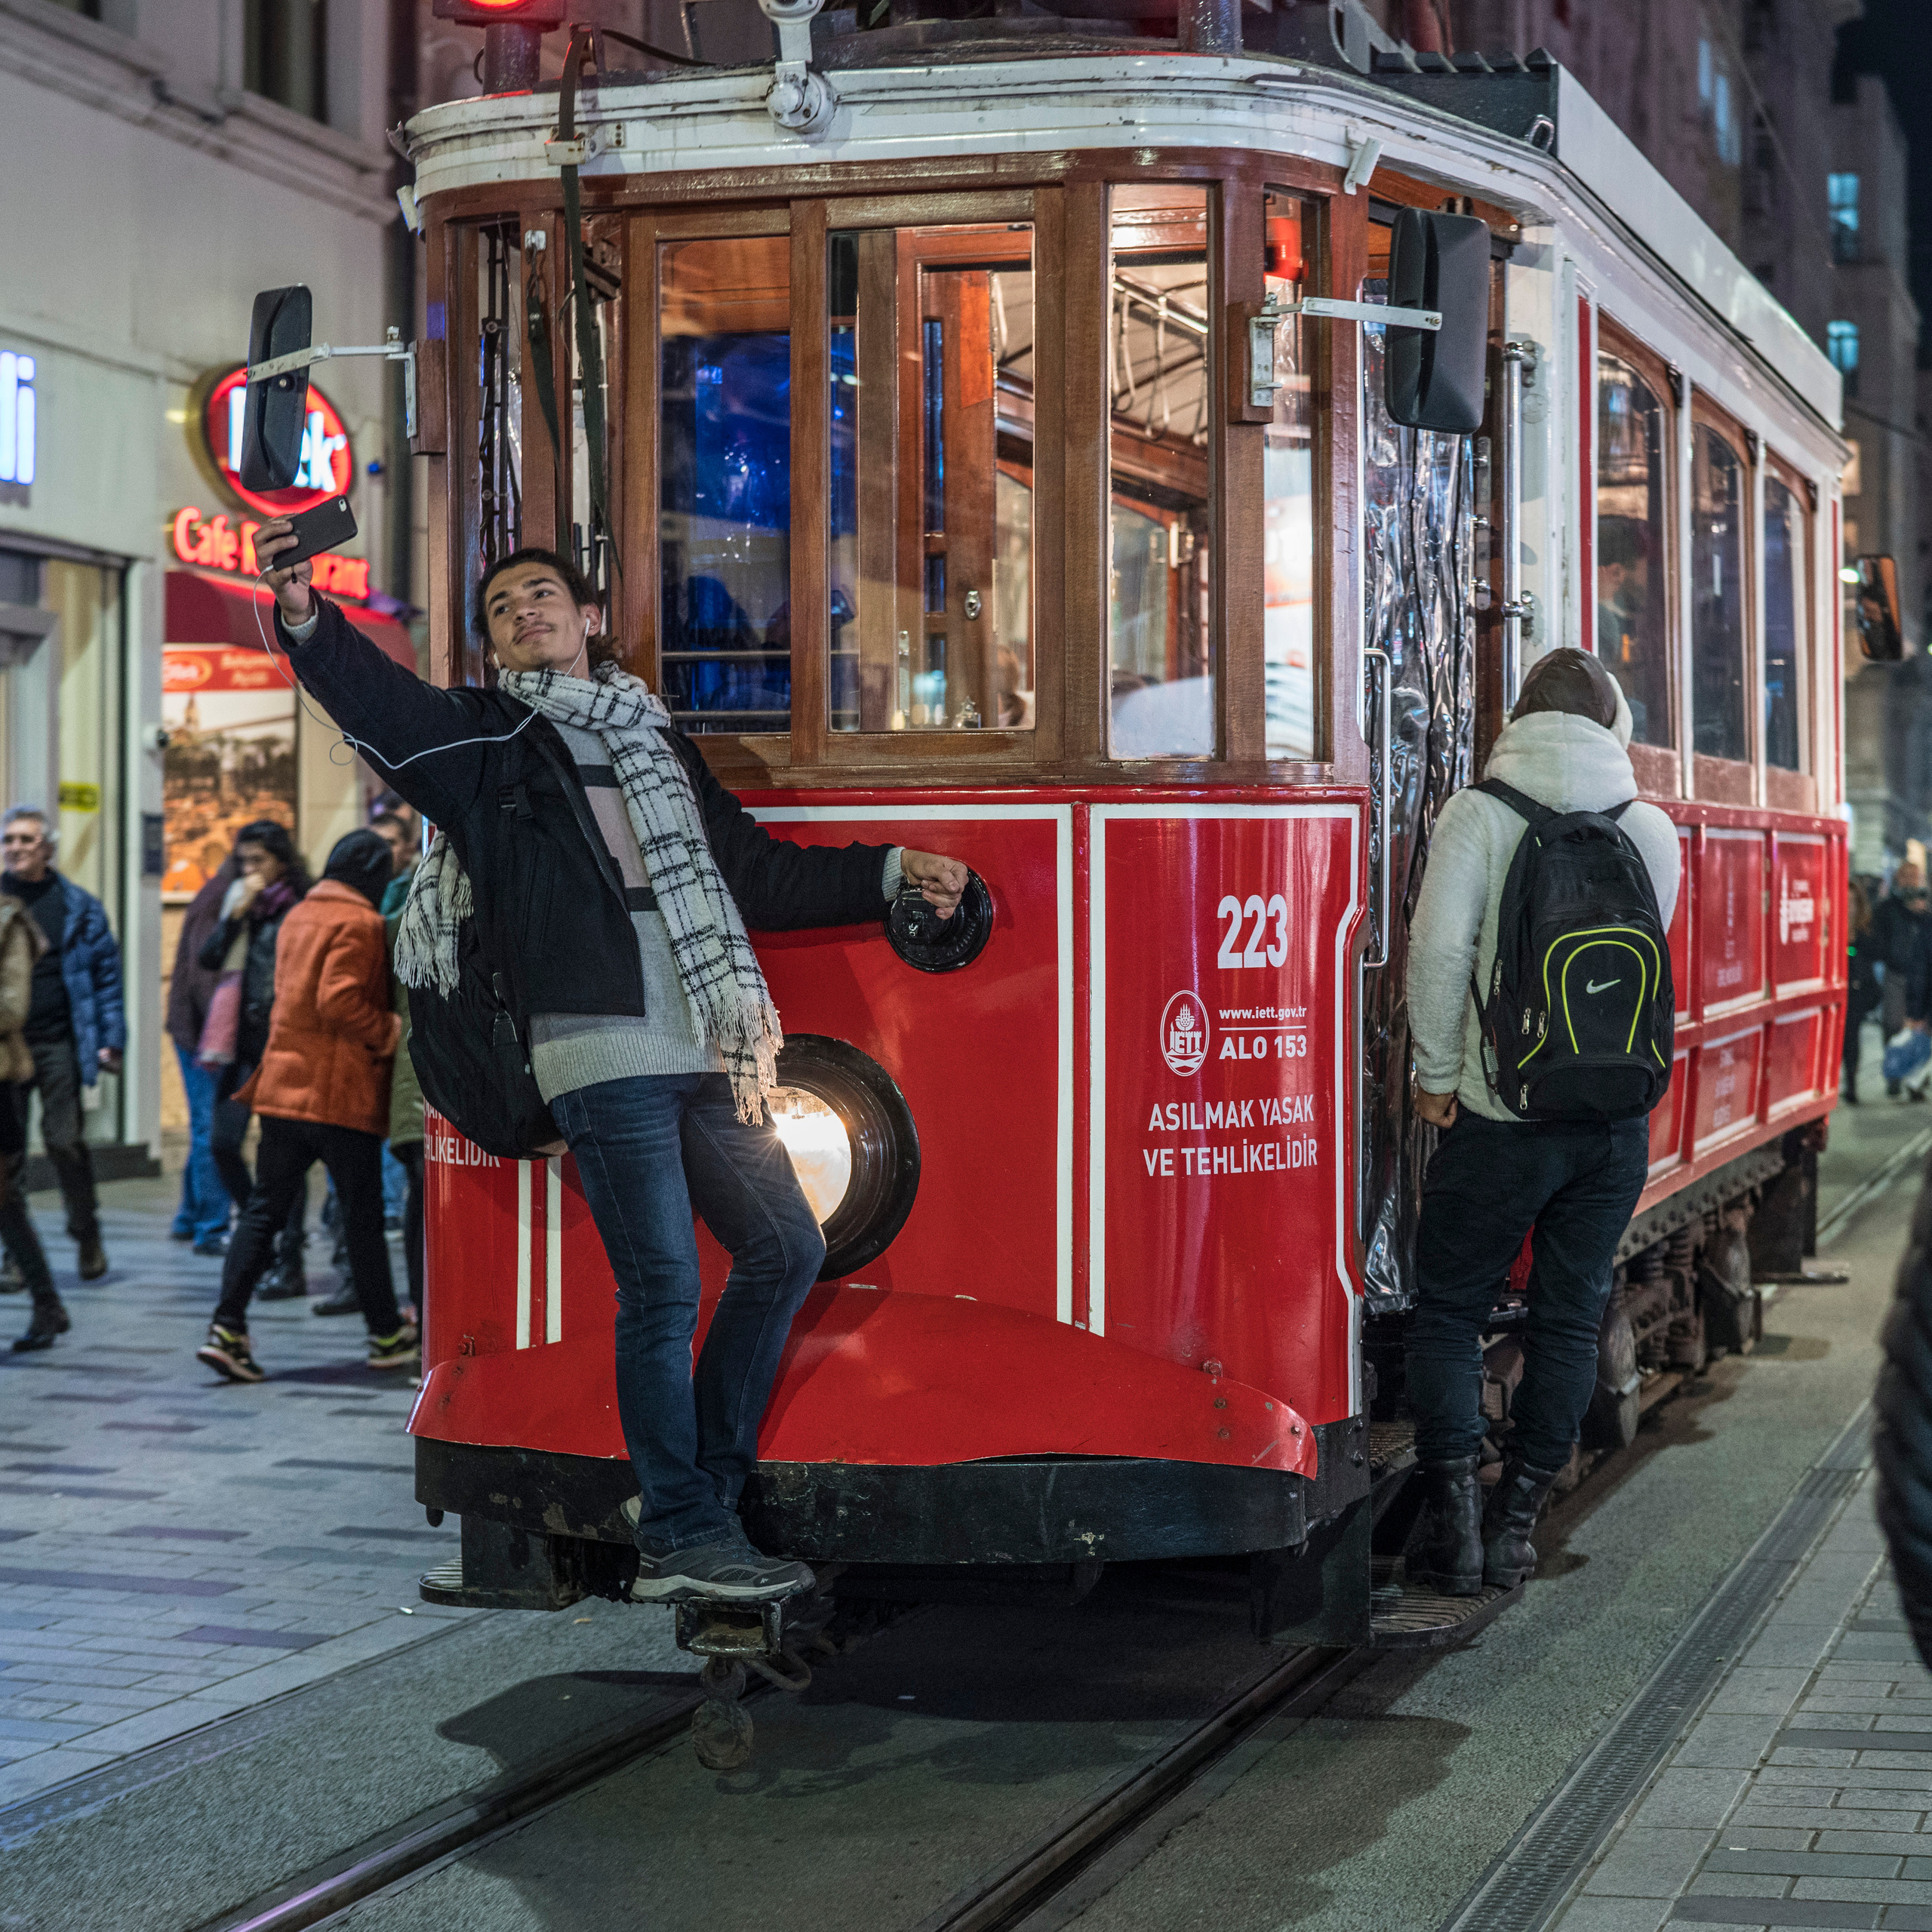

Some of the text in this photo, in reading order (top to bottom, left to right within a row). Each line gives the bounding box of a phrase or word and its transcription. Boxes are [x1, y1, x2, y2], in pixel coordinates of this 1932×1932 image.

[174, 506, 238, 571] Cafe
[1217, 894, 1288, 969] 223
[1218, 1006, 1307, 1021] www.iett.gov.tr
[1219, 1035, 1307, 1060] ALO 153
[1148, 1094, 1315, 1131] ASILMAK YASAK
[1143, 1134, 1318, 1177] VE TEHLİKELİDİR
